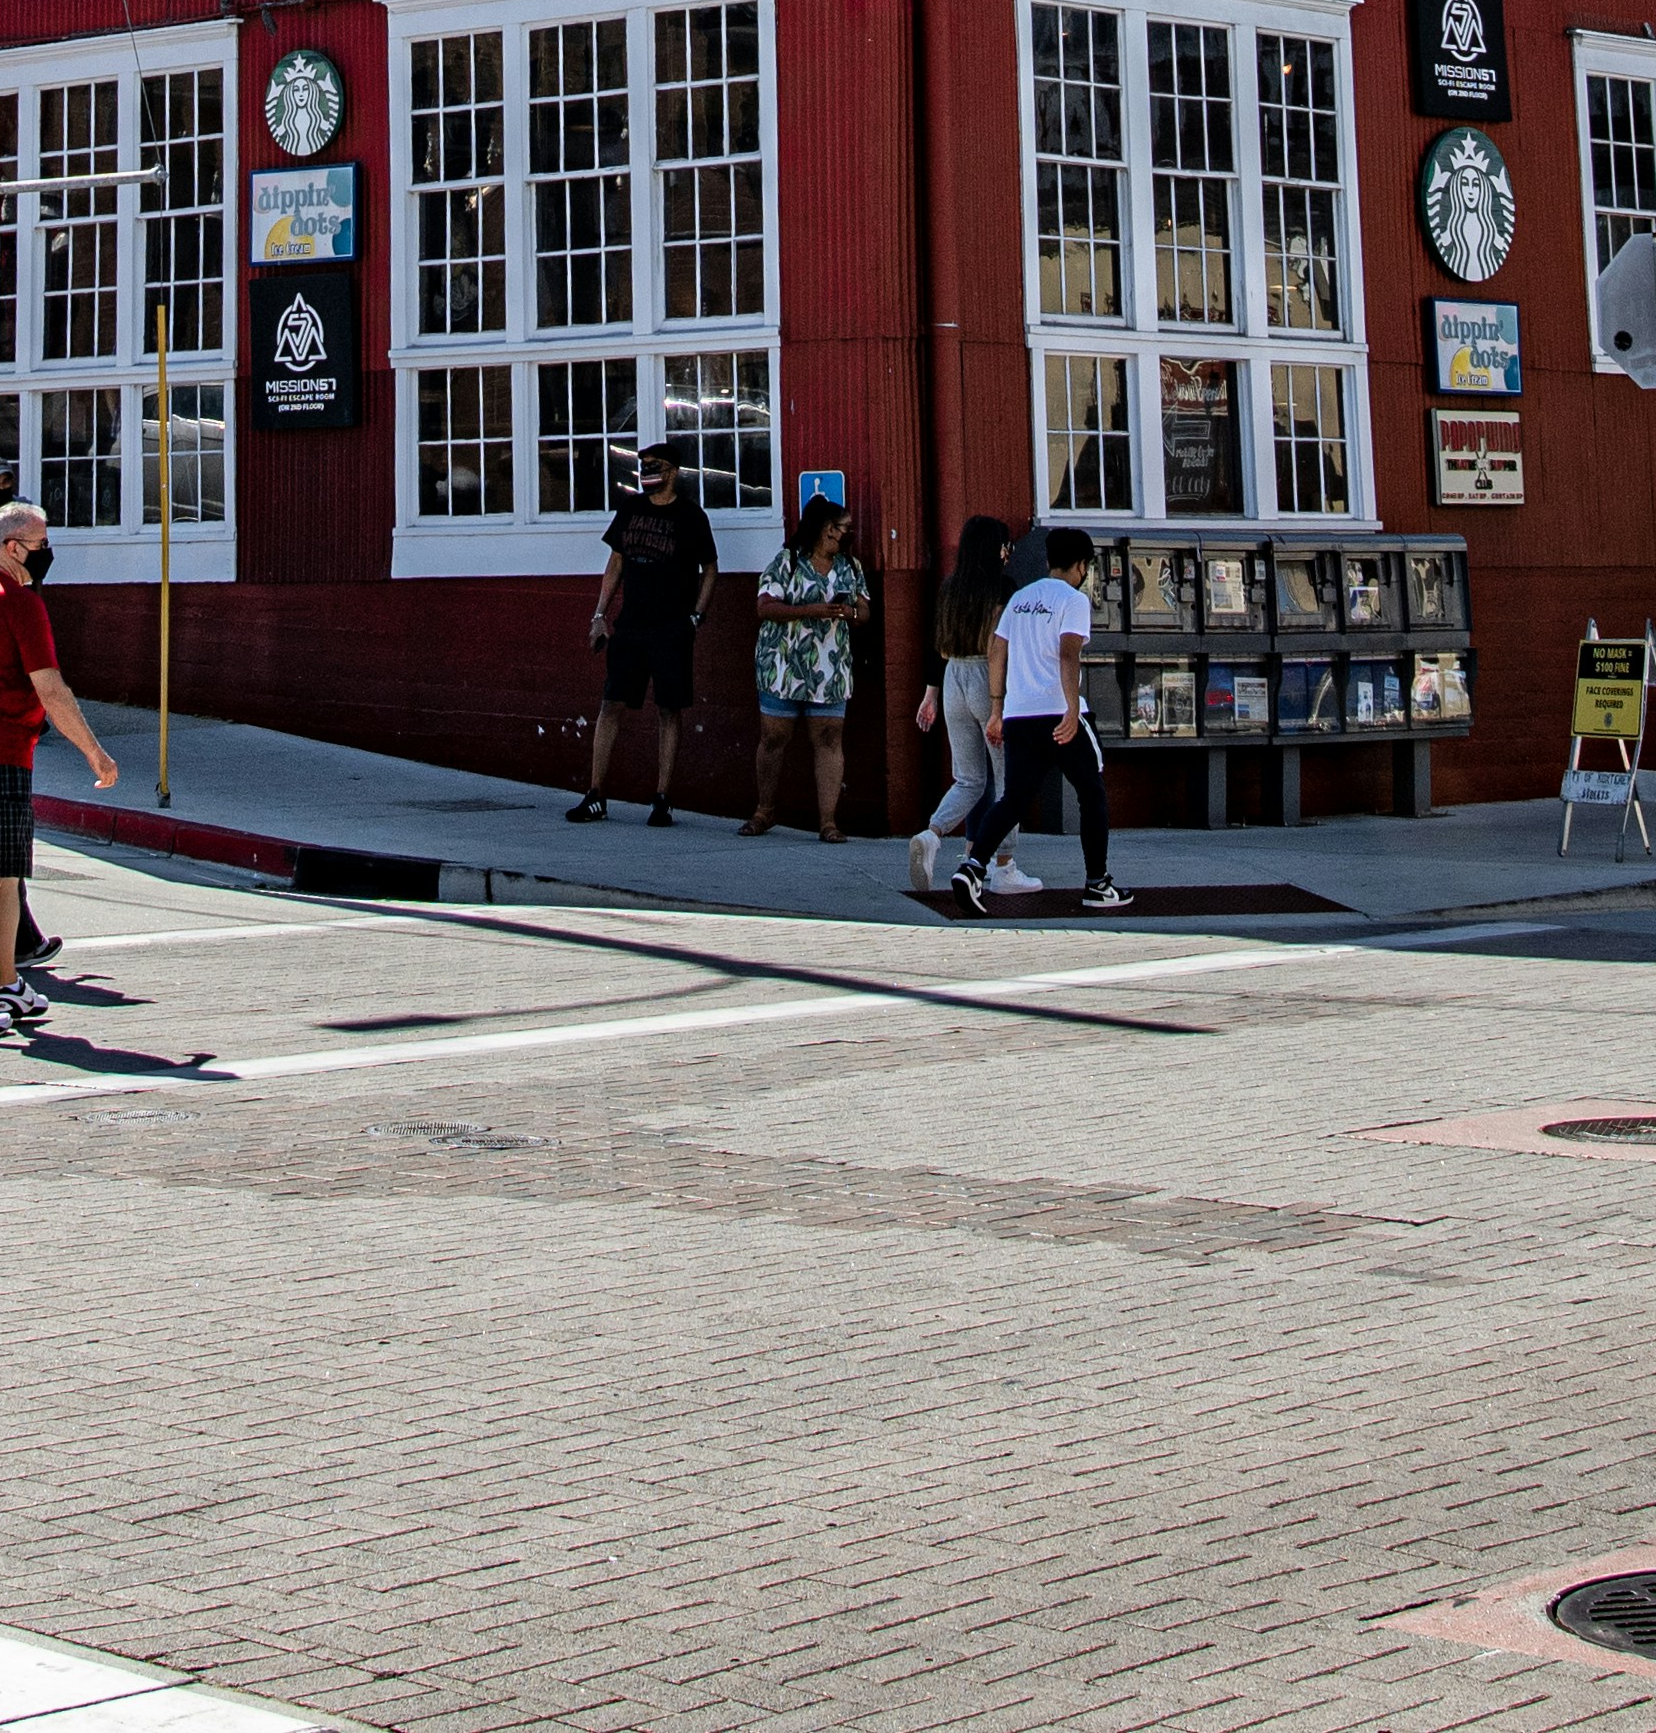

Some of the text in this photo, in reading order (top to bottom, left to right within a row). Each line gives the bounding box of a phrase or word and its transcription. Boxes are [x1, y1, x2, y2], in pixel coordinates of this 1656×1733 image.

[1434, 63, 1496, 83] MISSION57
[290, 211, 342, 237] dots
[1470, 345, 1510, 369] dots
[265, 378, 337, 394] MISSION57
[621, 531, 677, 556] DAVIDSON
[1593, 647, 1605, 659] NO
[1607, 648, 1627, 659] MASK
[1595, 661, 1630, 673] $100 FINE
[1586, 686, 1634, 696] FACE COVERINGS
[1595, 699, 1624, 709] REQUIRED
[1584, 772, 1593, 782] OF
